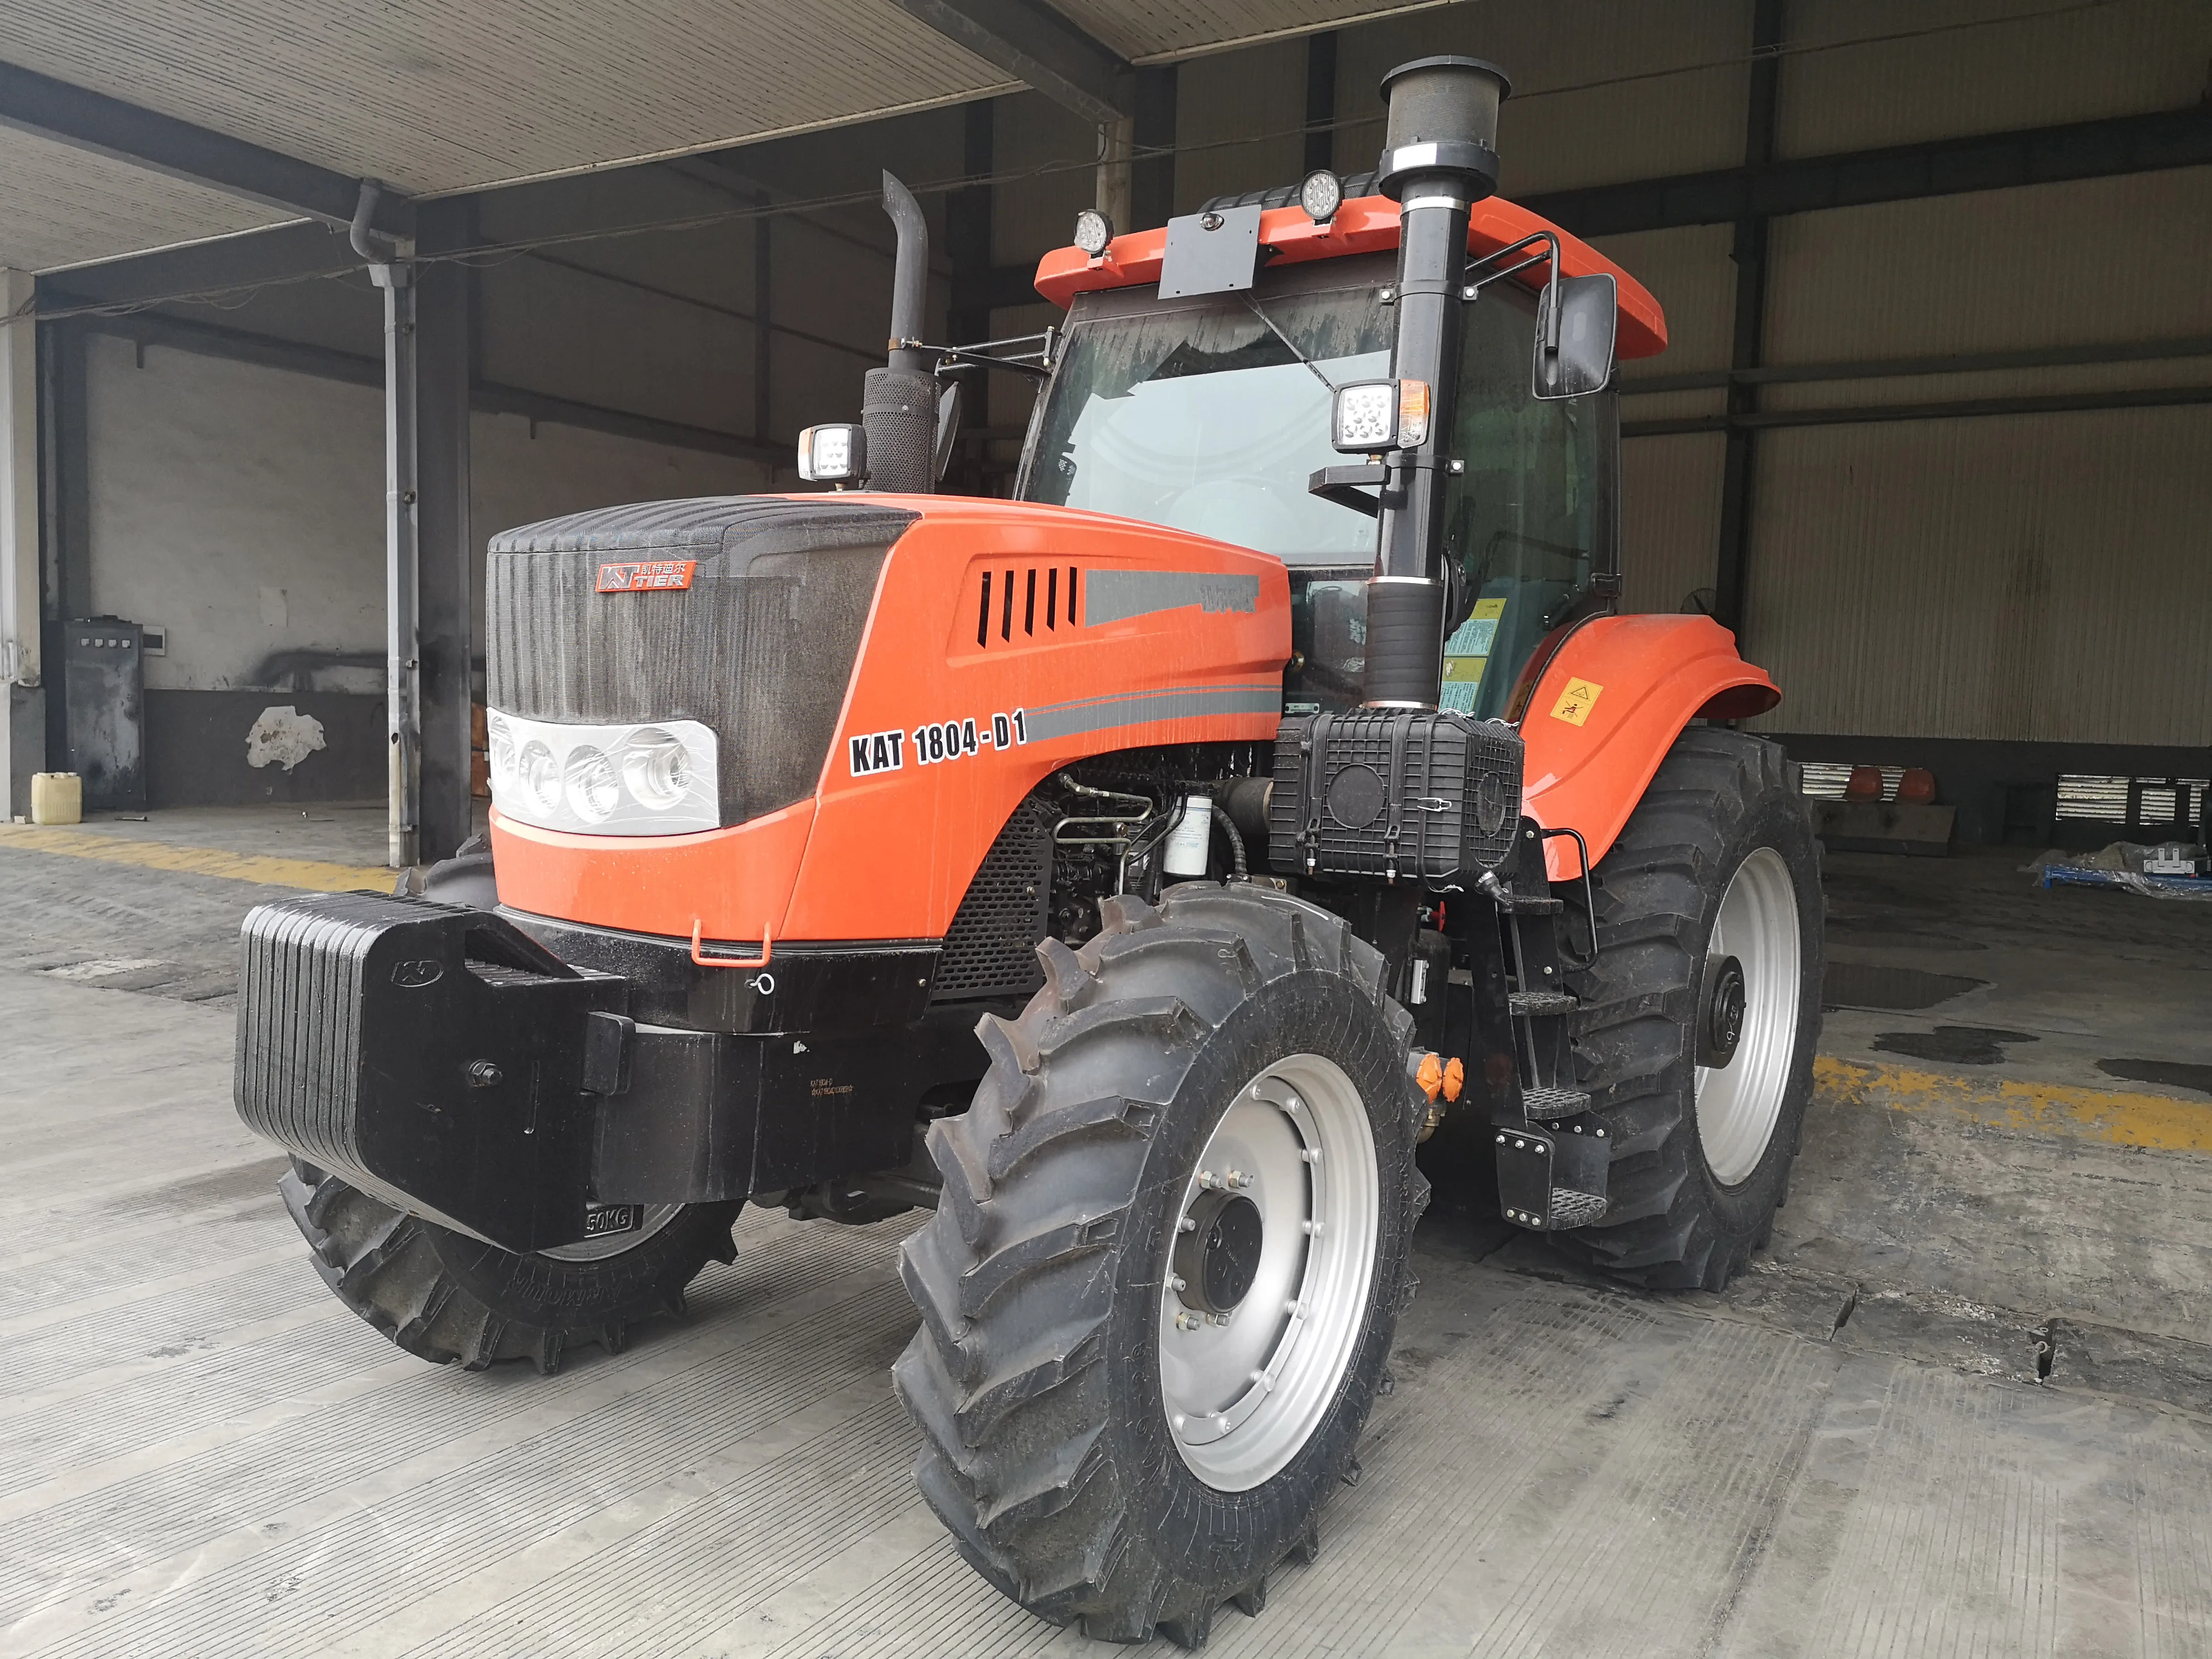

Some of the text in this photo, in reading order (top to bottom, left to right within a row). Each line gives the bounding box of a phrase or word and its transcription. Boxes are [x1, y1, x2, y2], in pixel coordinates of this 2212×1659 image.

[642, 562, 687, 575] 凯特迪尔
[634, 575, 685, 588] TIER
[850, 709, 1026, 775] KAT 1804-D1
[586, 1207, 628, 1230] 50KG
